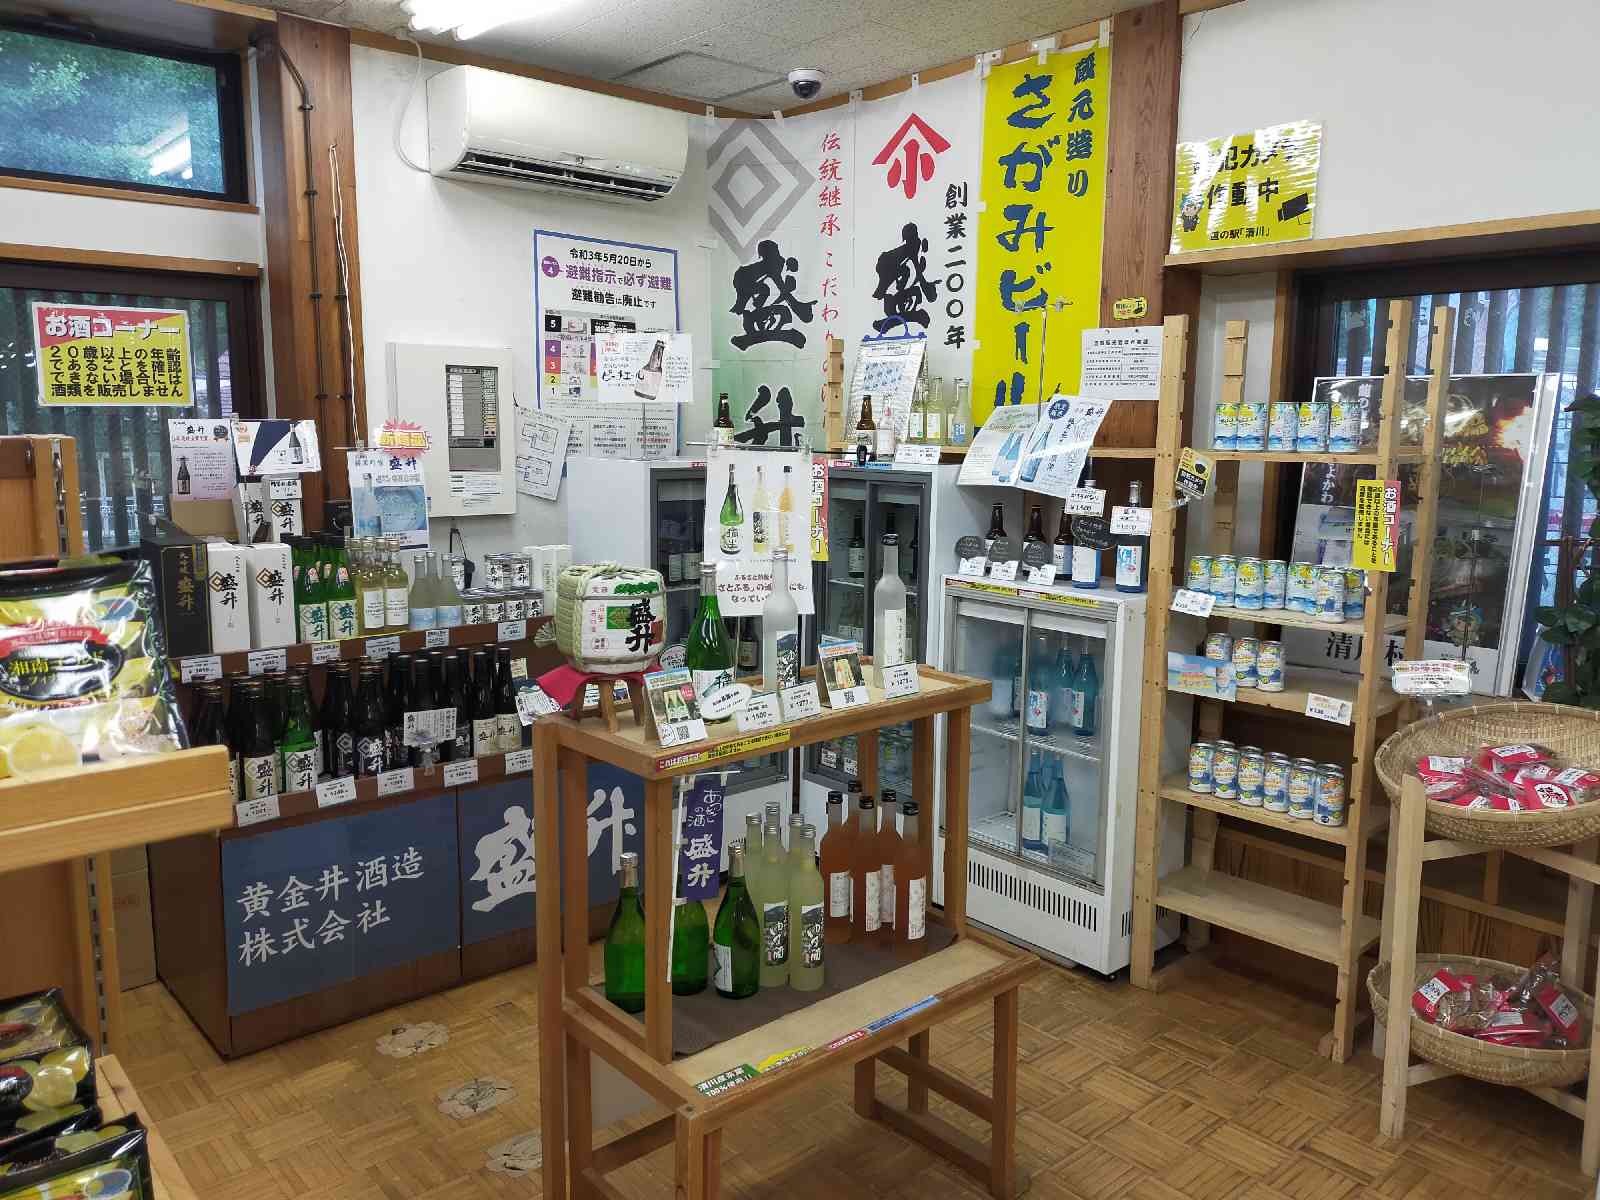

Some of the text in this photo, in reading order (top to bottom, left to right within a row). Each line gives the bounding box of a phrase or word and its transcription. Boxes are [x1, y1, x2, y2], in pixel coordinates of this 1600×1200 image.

[817, 130, 842, 238] 伝統継承
[569, 247, 653, 269] 令和3年5月20日から
[565, 264, 673, 291] 避難指示で必ず避難
[571, 287, 657, 309] 避難勧告は廃止です
[45, 314, 181, 340] お酒コーナー
[550, 319, 556, 328] 5
[50, 372, 182, 385] できない場合には
[550, 361, 556, 370] 3
[550, 375, 556, 383] 2
[51, 384, 183, 397] 酒類を販売しません
[220, 573, 239, 609] 盛升
[269, 569, 285, 606] 盛升
[625, 598, 657, 654] 盛升
[1326, 631, 1404, 666] 清村
[256, 760, 273, 796] 盛升
[297, 753, 314, 790] 盛升
[684, 833, 719, 888] 盛升
[237, 847, 425, 922] 黄金井酒造
[238, 900, 392, 967] 株式会社
